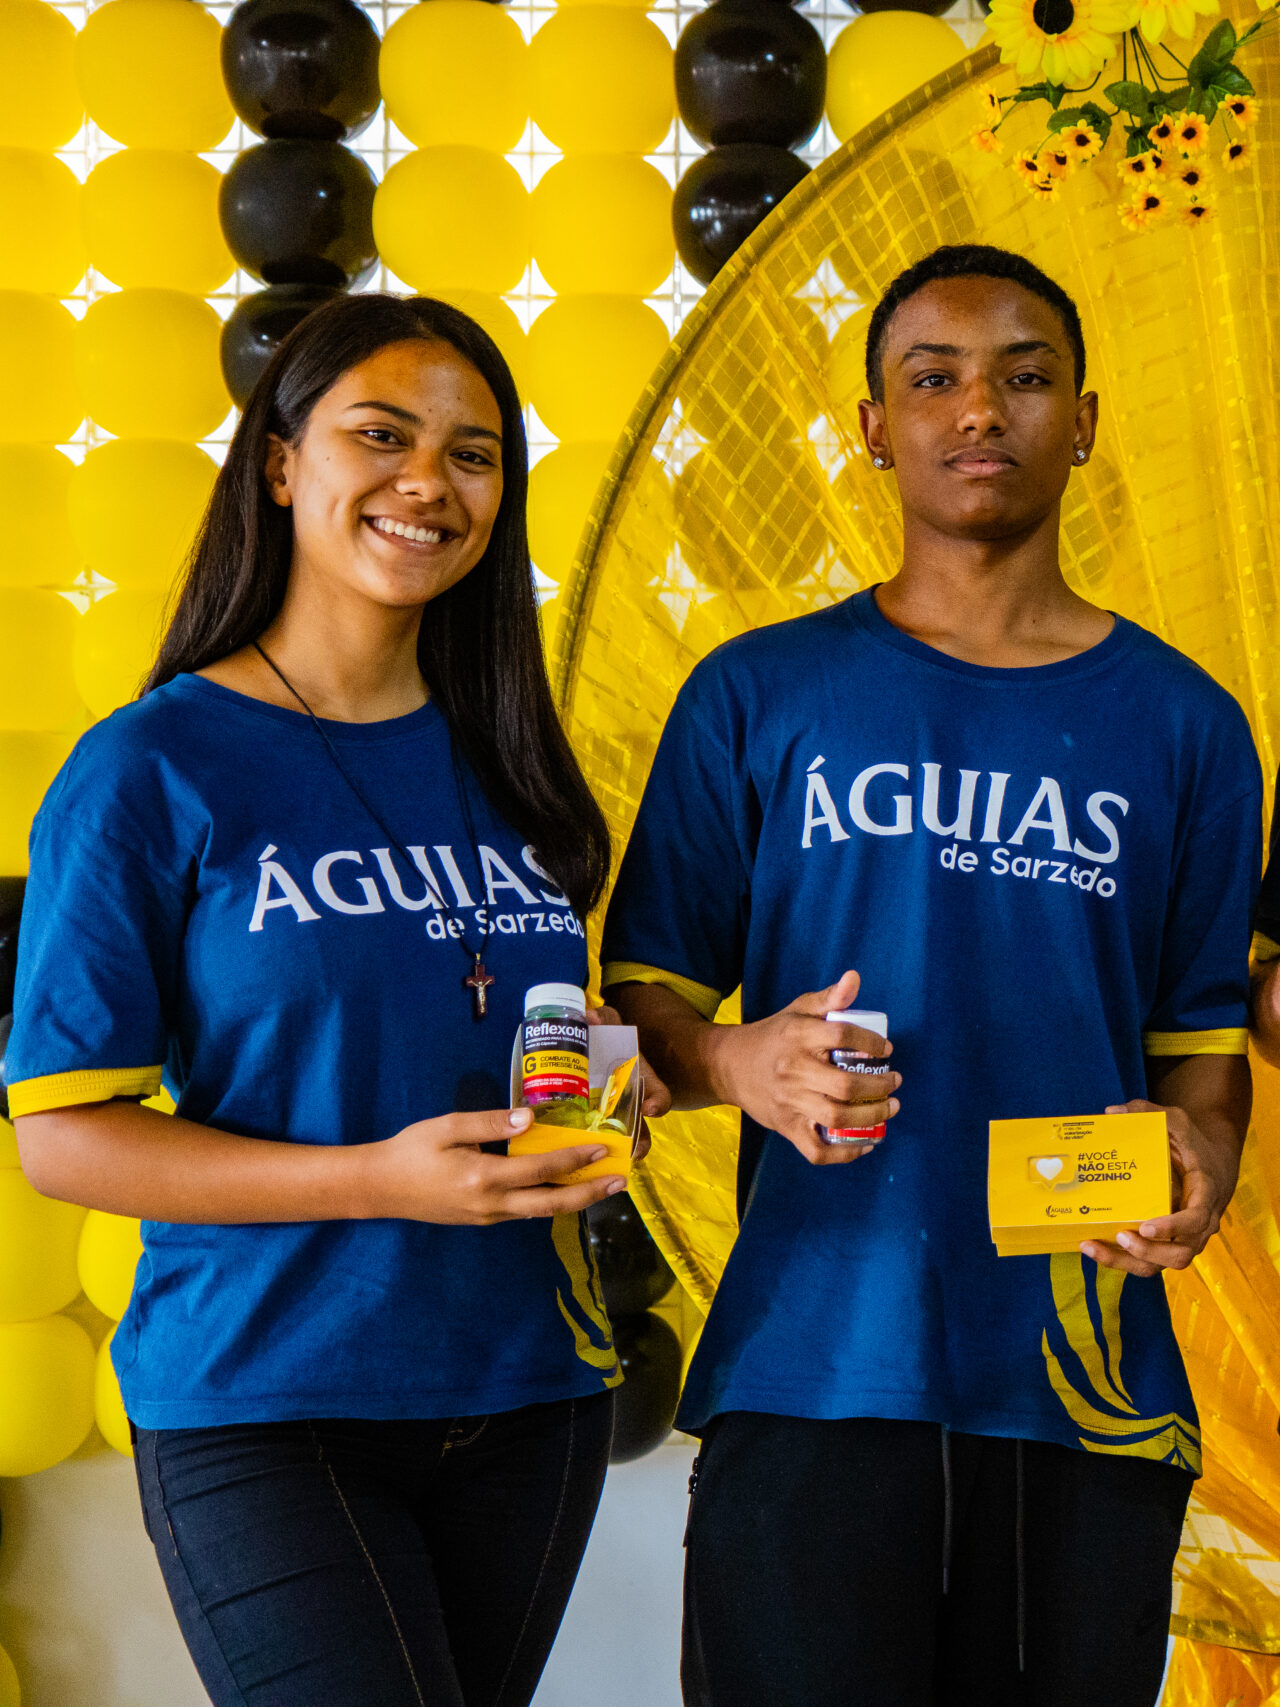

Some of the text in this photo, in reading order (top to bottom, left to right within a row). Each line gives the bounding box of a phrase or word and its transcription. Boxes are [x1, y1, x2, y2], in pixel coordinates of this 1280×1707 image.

[802, 755, 1129, 864] ÁGUIAS
[940, 843, 1117, 897] de Sarzedo
[426, 909, 585, 940] de Sarzedo
[525, 1022, 587, 1041] Reflexotril
[525, 1056, 537, 1074] G
[572, 1057, 580, 1065] AO
[1077, 1149, 1118, 1161] #VOCÊ
[1077, 1160, 1137, 1172] NÃO ESTÁ
[1077, 1172, 1132, 1183] SOZINHO
